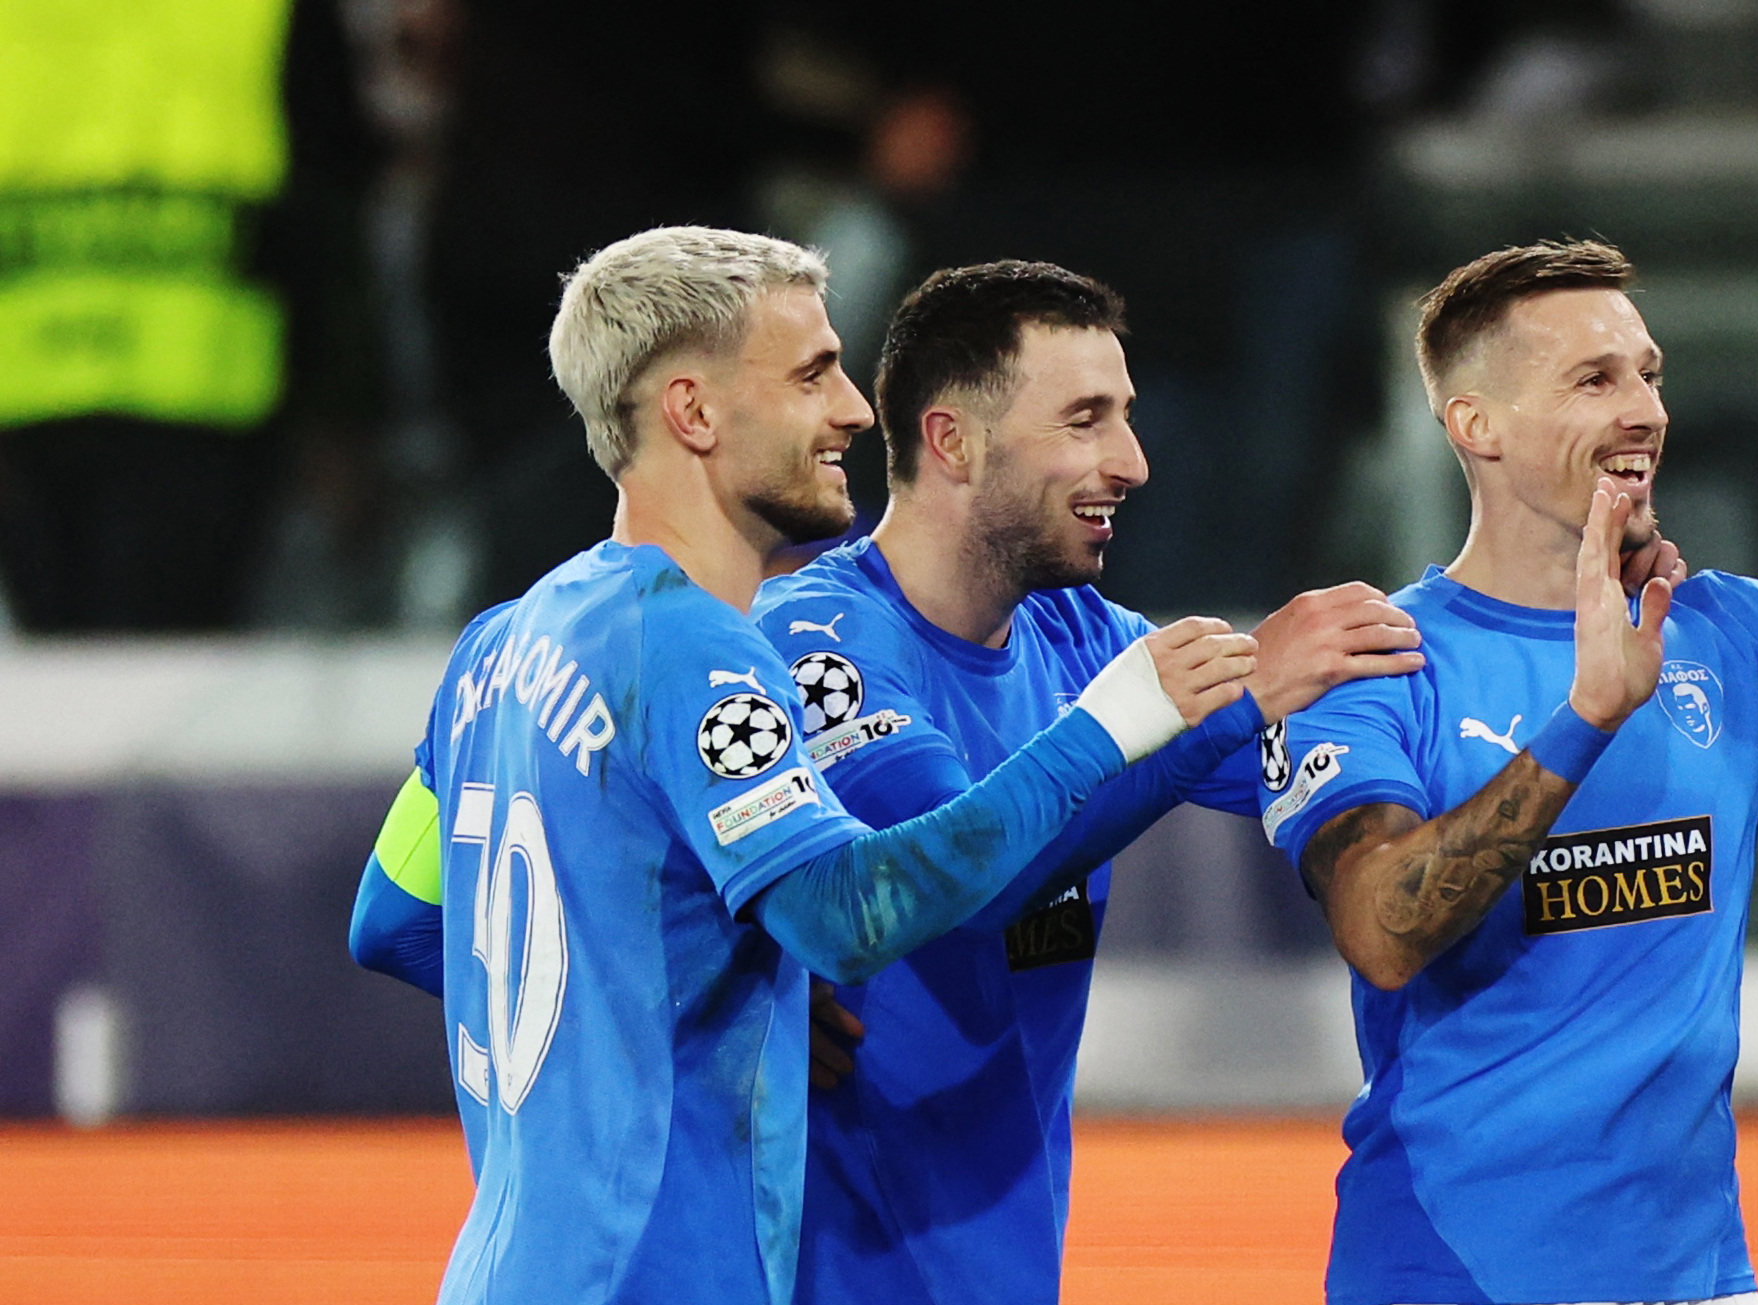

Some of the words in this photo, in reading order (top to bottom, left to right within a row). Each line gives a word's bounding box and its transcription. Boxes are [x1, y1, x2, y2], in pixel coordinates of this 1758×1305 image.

[716, 786, 793, 831] FOUNDATION
[1530, 829, 1707, 875] KORANTINA
[1536, 861, 1704, 922] HOMES
[451, 782, 569, 1115] 30
